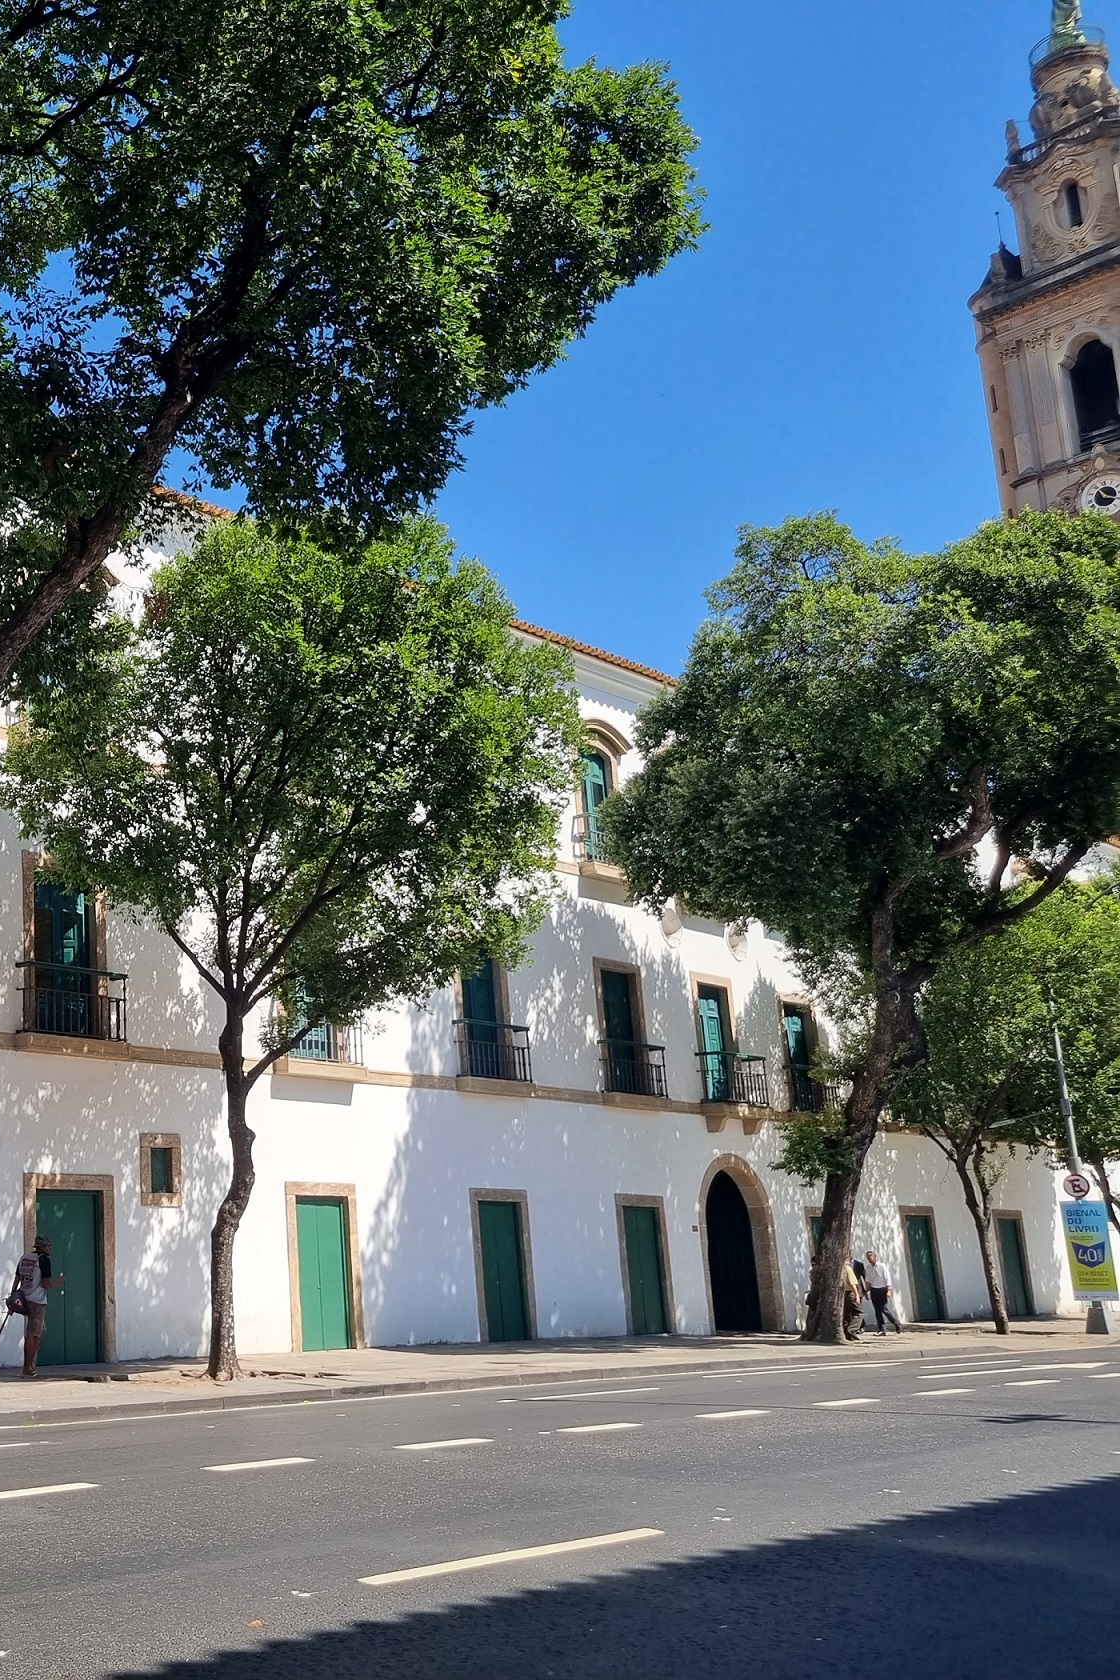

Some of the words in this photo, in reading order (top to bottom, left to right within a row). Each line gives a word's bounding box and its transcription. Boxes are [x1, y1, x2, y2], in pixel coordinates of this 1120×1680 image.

[1071, 1178, 1082, 1193] E
[1066, 1209, 1102, 1217] BIENAL
[1067, 1217, 1082, 1225] DO
[1068, 1225, 1099, 1233] LIVRO
[1078, 1248, 1098, 1262] 40
